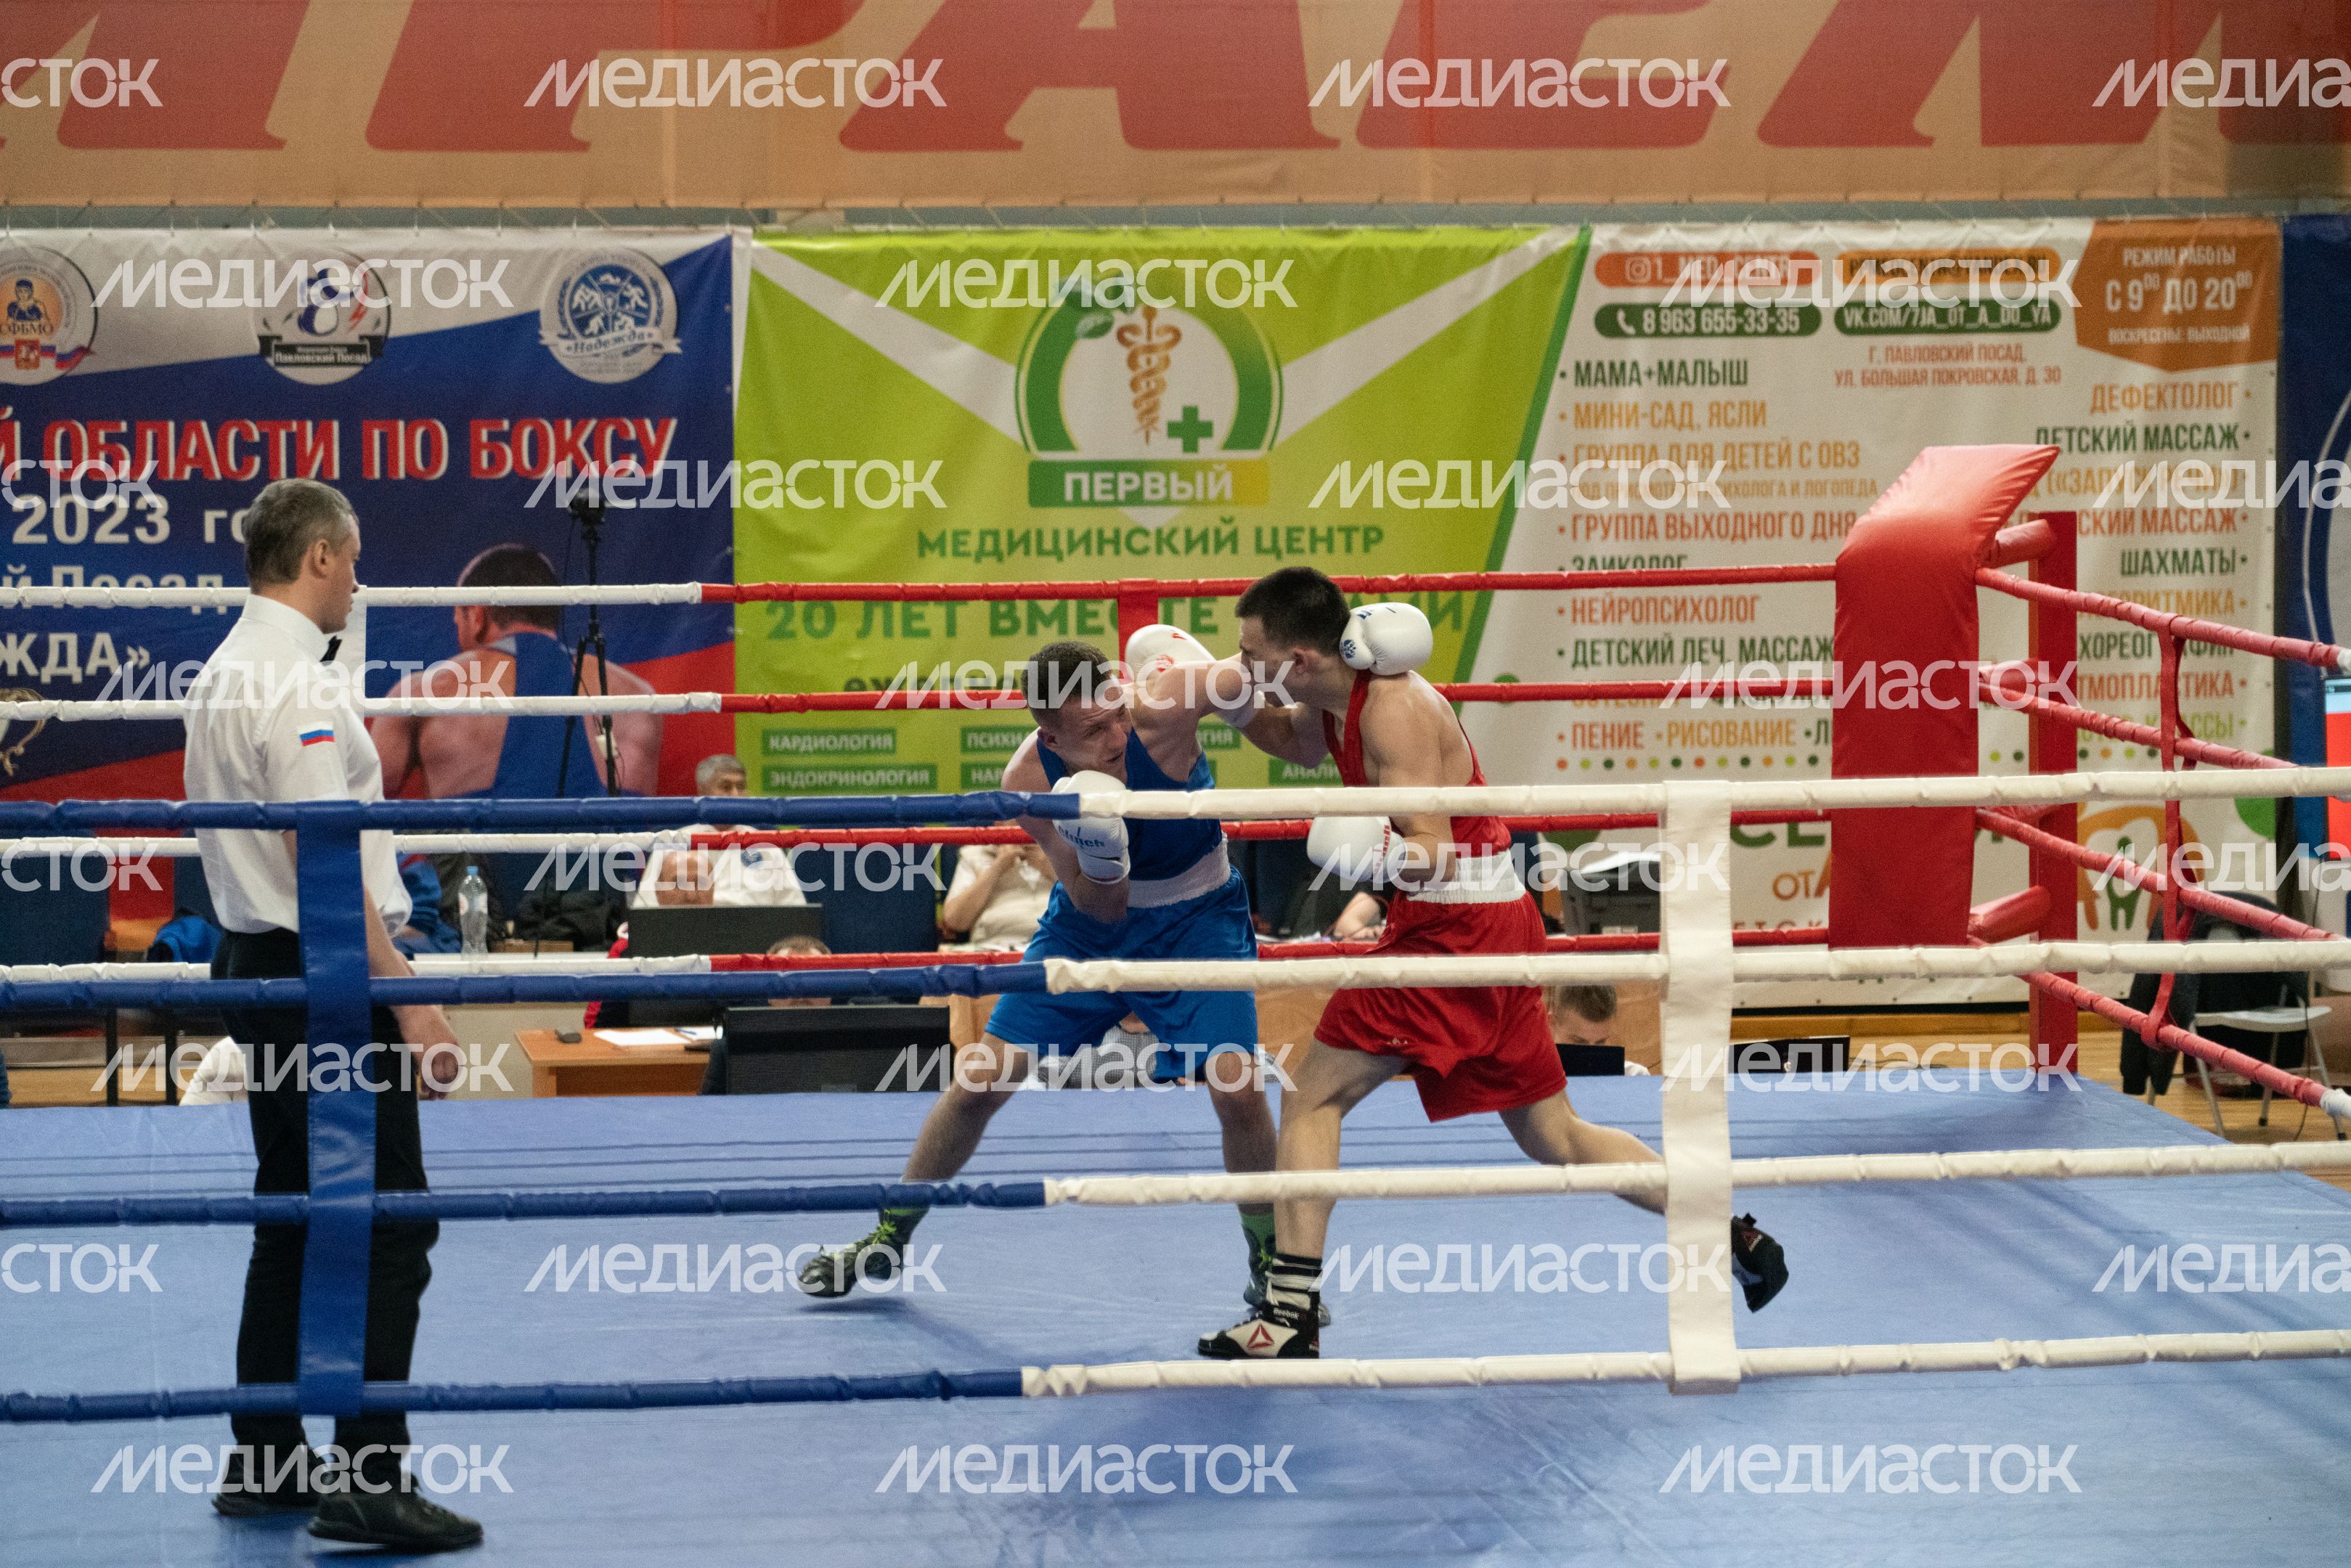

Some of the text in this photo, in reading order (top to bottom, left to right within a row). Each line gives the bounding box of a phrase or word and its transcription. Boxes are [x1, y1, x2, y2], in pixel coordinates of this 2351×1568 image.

[2162, 277, 2199, 314] ДО
[1660, 308, 1697, 335] 963
[1701, 307, 1801, 335] 655-33-35
[1708, 400, 1767, 428] ЯСЛИ
[2089, 381, 2239, 415] ДЕФЕКТОЛОГ
[42, 419, 340, 482] ОБЛАСТИ
[362, 418, 449, 480] ПО
[469, 417, 678, 480] БОКСУ
[2143, 422, 2240, 452] МАССАЖ
[1723, 436, 1793, 473] ДЕТЕЙ
[1818, 439, 1860, 469] ОВЗ
[1063, 463, 1233, 503] ПЕРВЫЙ
[12, 494, 171, 544] 2023
[1572, 512, 1658, 542] ГРУППА
[1663, 510, 1804, 544] ВЫХОДНОГО
[2141, 507, 2238, 536] МАССАЖ
[917, 516, 1384, 564] МЕДИЦИНСКИЙ ЦЕНТР
[2120, 547, 2236, 577] ШАХМАТЫ
[765, 595, 1219, 640] 20 ЛЕТ ВМЕТЕ
[1570, 592, 1760, 626] НЕЙРОПСИХОЛОГ
[1570, 632, 1674, 670] ДЕТСКИЙ
[1570, 721, 1645, 751] ПЕНИЕ
[1666, 718, 1798, 749] РИСОВАНИЕ
[1273, 1307, 1300, 1320] Reebok
